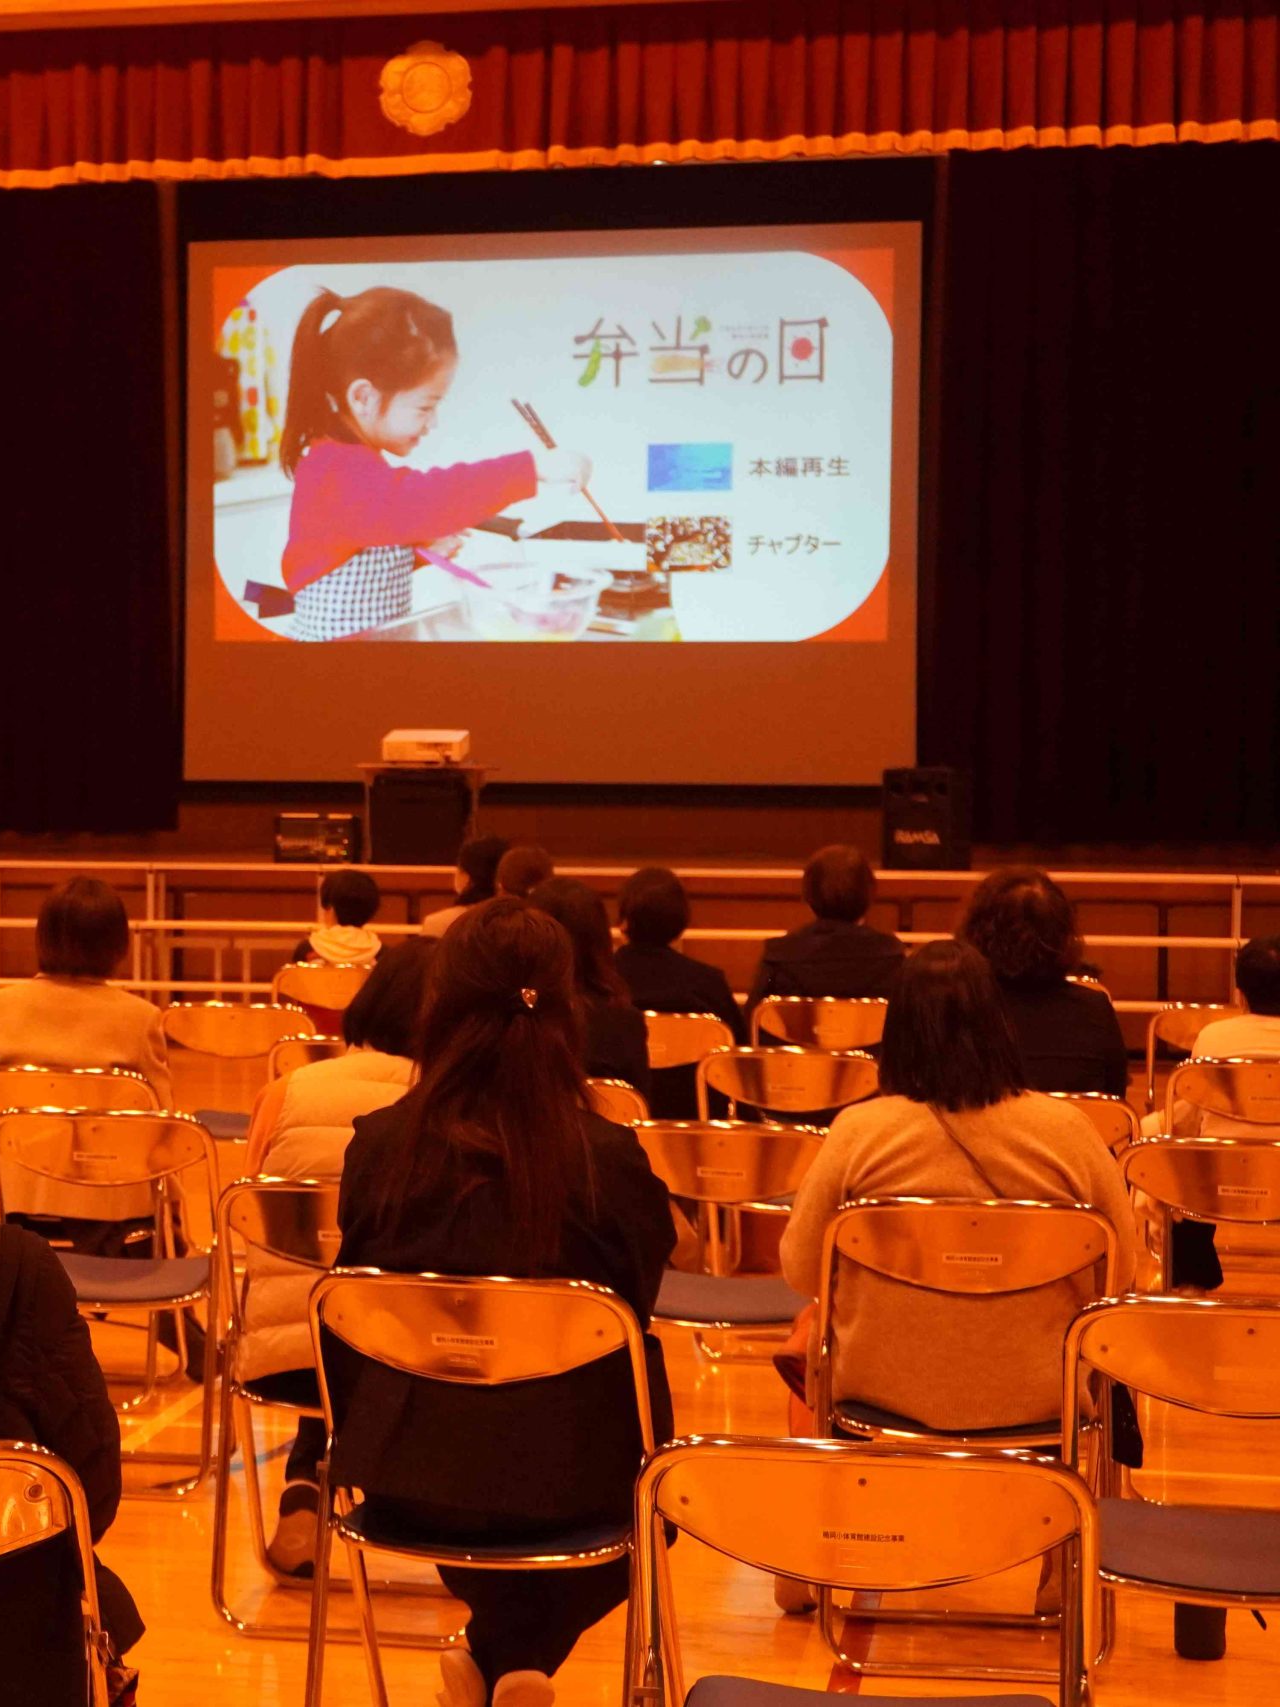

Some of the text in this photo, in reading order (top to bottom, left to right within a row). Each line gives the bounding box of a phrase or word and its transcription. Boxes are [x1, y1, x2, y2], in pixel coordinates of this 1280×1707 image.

[748, 456, 851, 479] 本編再生
[746, 534, 842, 556] チャプター
